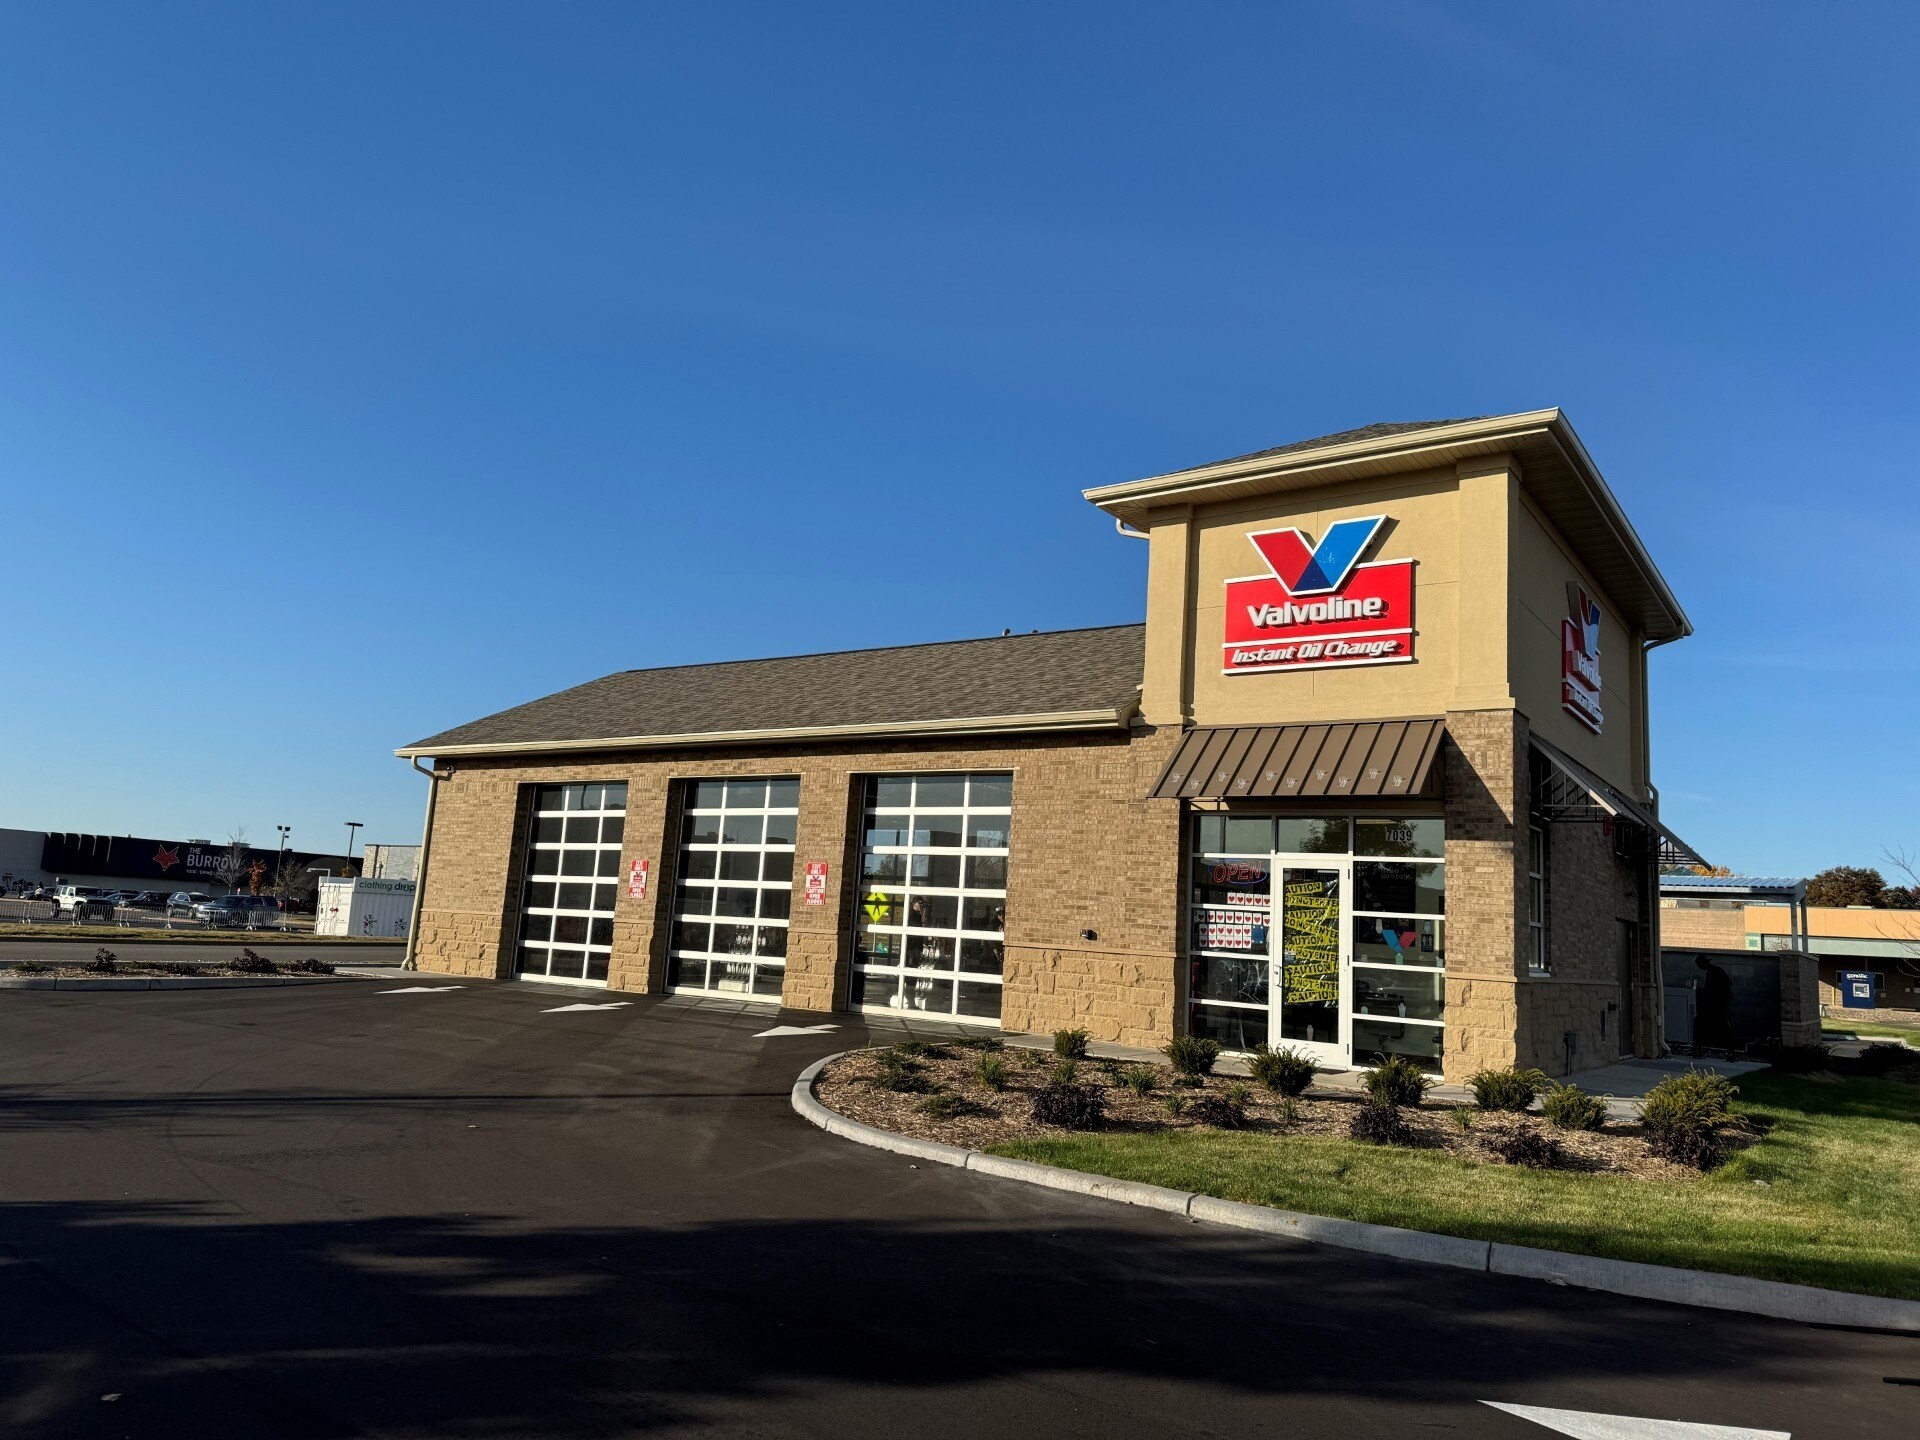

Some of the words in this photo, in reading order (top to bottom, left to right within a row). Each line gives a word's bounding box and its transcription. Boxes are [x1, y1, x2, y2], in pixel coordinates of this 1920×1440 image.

[1247, 596, 1383, 627] Valvoline
[1231, 645, 1297, 664] Instant
[1297, 642, 1324, 659] Oil
[1324, 639, 1398, 657] Change
[1386, 830, 1412, 841] 7039
[189, 847, 201, 855] THE
[186, 854, 241, 871] BURROW
[1213, 861, 1262, 883] OPEN
[359, 881, 393, 891] clothing
[1285, 882, 1321, 894] AUTION
[1287, 963, 1331, 976] CAUTION
